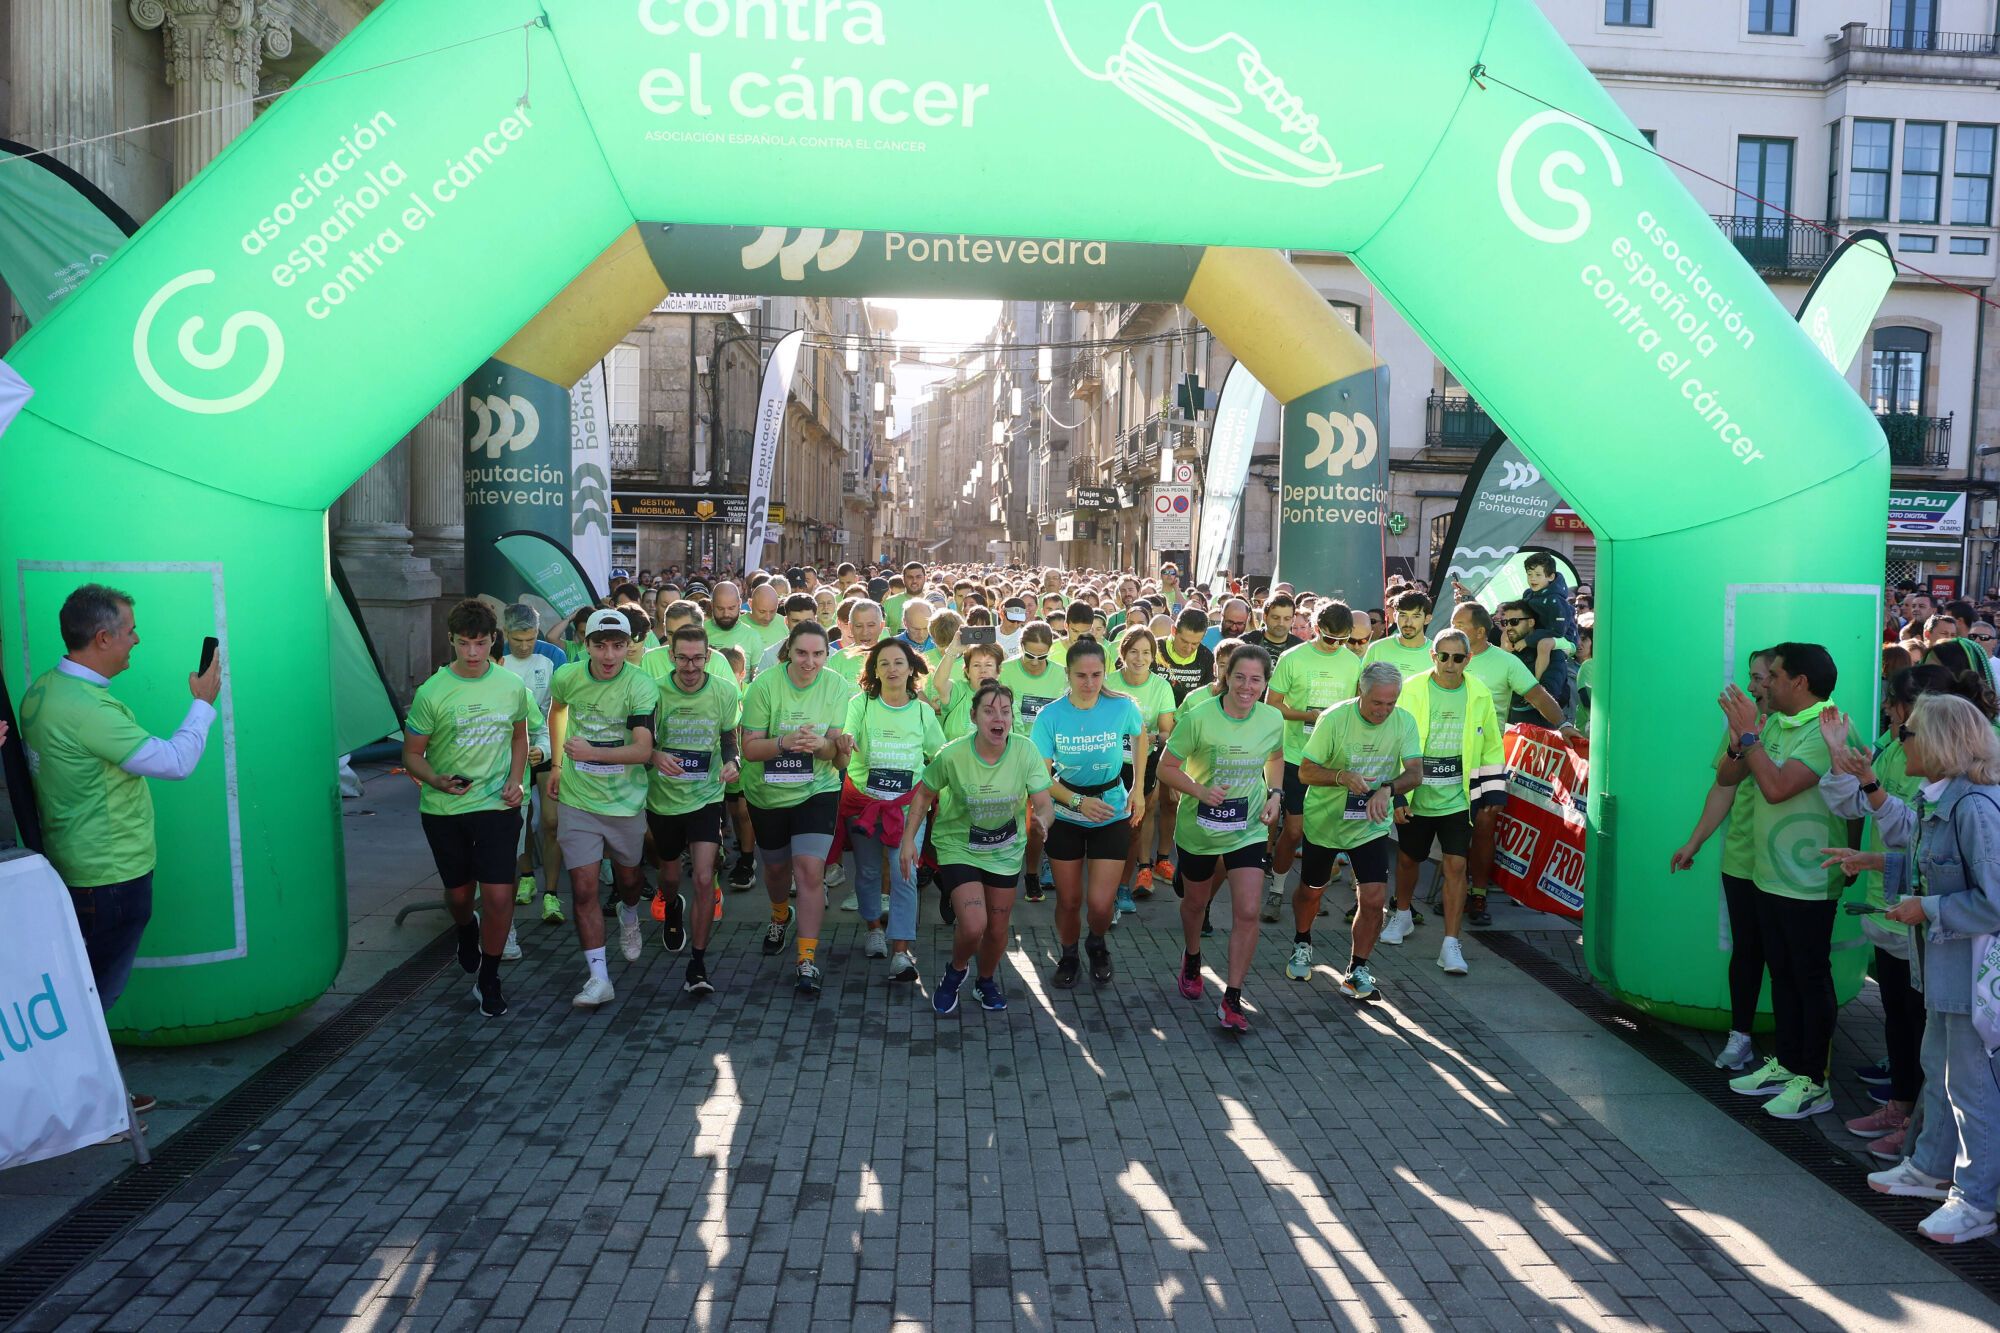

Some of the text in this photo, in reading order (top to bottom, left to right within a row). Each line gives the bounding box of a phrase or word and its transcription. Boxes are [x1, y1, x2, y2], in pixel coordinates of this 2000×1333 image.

[639, 0, 886, 46] contra
[638, 53, 989, 128] el cáncer
[729, 132, 796, 146] ESPAÑOLA
[799, 136, 852, 149] CONTRA
[856, 138, 871, 150] EL
[240, 109, 397, 256] asociación
[303, 103, 532, 321] contra el cáncer
[271, 157, 408, 288] española
[884, 231, 1107, 267] Pontevedra
[1636, 209, 1757, 351] asociación
[1611, 236, 1719, 359] española
[1581, 263, 1765, 467] contra el cáncer
[757, 399, 775, 488] Deputación
[1212, 407, 1238, 497] Deputación
[1223, 408, 1249, 498] Pontevedra
[1078, 498, 1100, 506] Deza
[1079, 490, 1100, 498] Viajes
[1481, 491, 1548, 507] Deputación
[632, 507, 686, 515] INMOBILIARIA
[1479, 501, 1546, 518] Pontevedra
[1903, 512, 1928, 520] DIGITAL
[1168, 674, 1201, 682] INFERNO
[1055, 733, 1070, 744] En
[1072, 731, 1117, 743] marcha
[775, 759, 803, 768] 0888
[1216, 757, 1228, 765] En
[1432, 764, 1456, 773] 2668
[1511, 737, 1564, 782] FROIZ
[878, 778, 902, 789] 2274
[1209, 808, 1236, 818] 1398
[981, 831, 1007, 843] 1397
[1546, 884, 1580, 906] www.froiz.com
